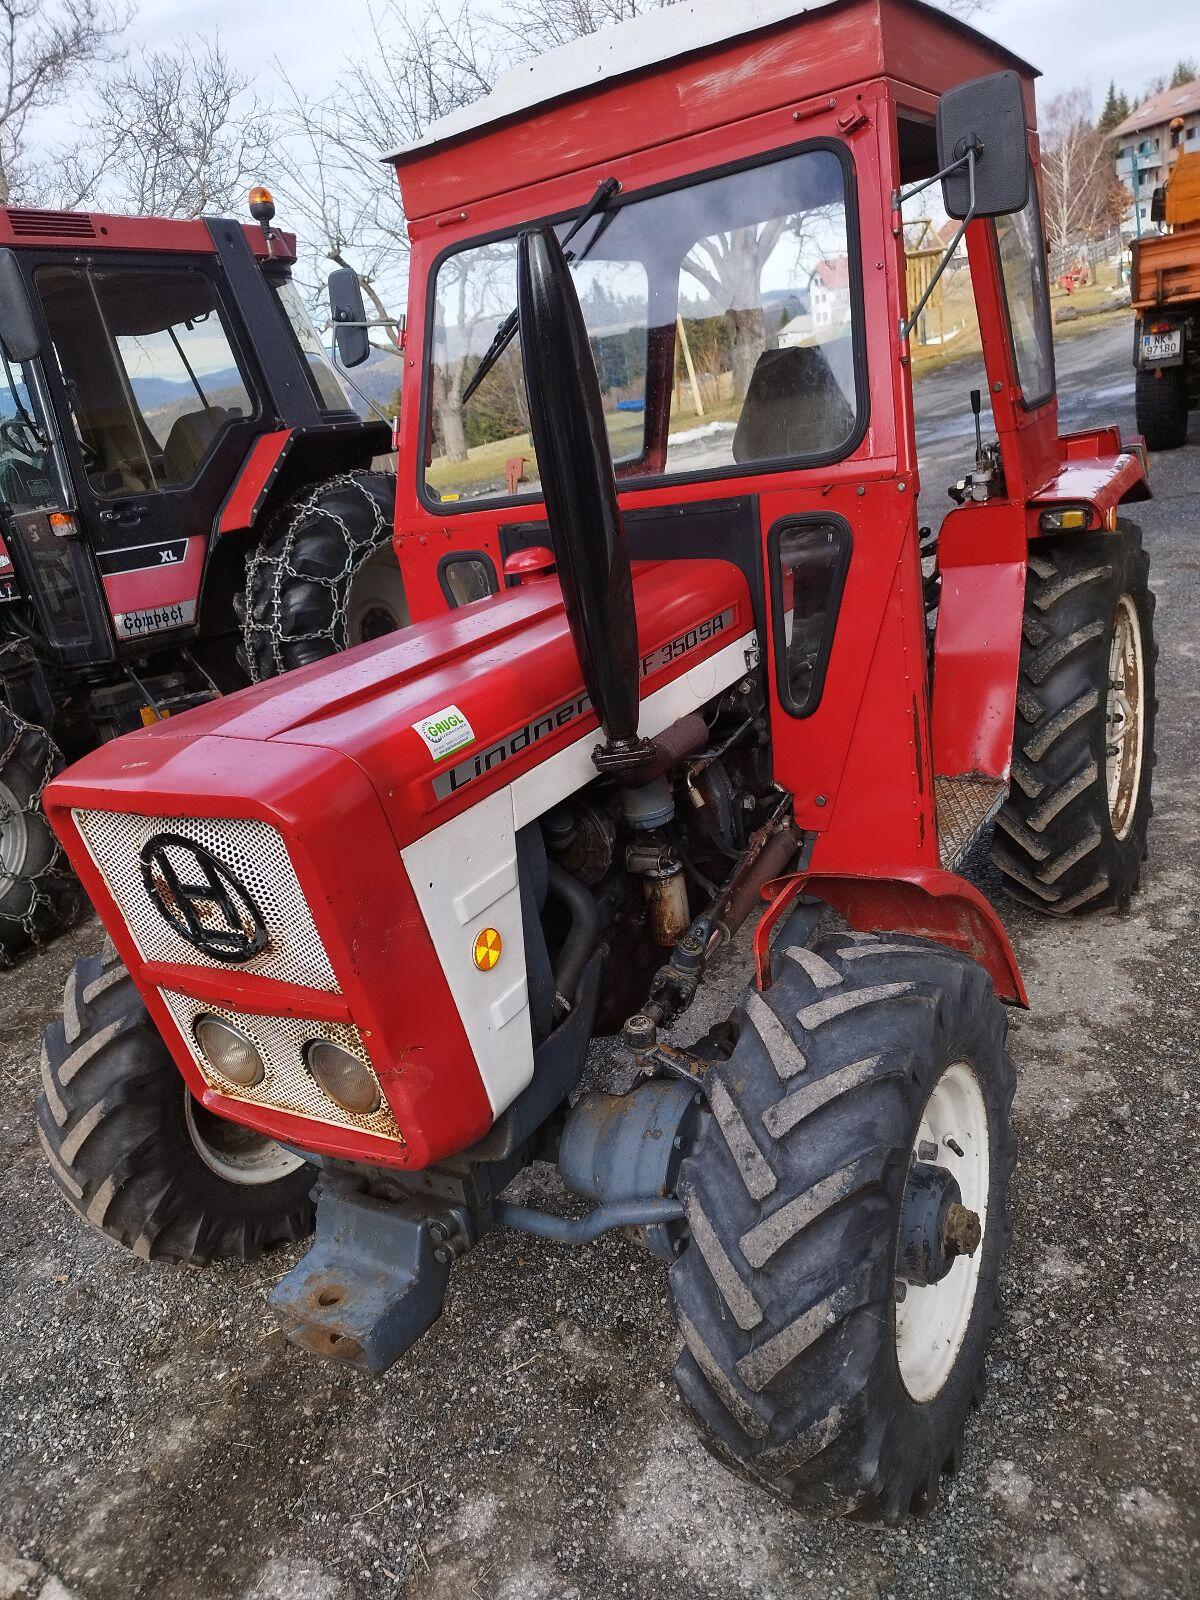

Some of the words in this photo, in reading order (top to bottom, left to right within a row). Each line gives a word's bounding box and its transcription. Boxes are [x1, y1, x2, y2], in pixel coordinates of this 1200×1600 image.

[1154, 335, 1166, 345] NK
[158, 550, 178, 563] XL
[123, 604, 184, 635] Compact
[427, 714, 465, 737] GAUGL
[449, 695, 590, 792] Lindner
